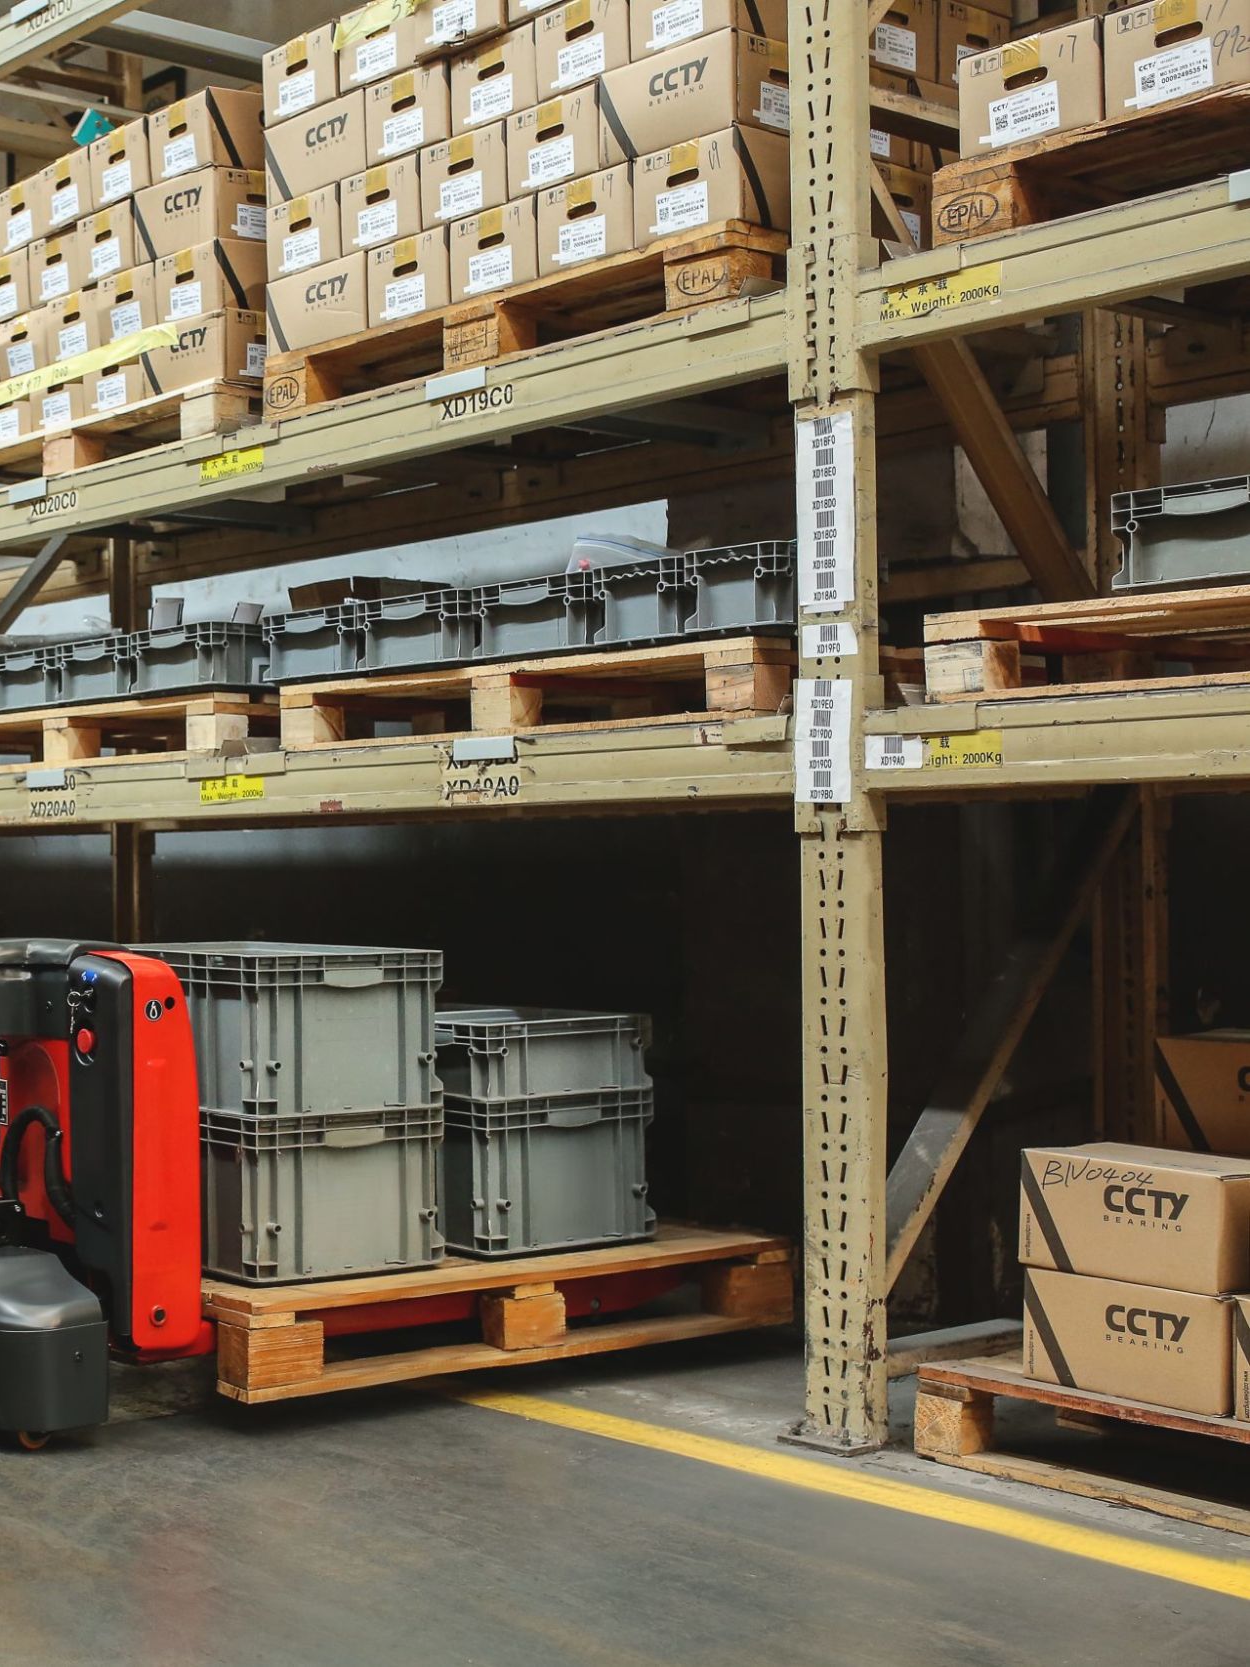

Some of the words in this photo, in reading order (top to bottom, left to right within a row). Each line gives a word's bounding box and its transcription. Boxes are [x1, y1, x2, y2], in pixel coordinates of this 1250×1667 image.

[649, 57, 708, 97] CCTY
[648, 84, 704, 107] BEARING
[305, 112, 348, 148] CCTY
[164, 186, 202, 214] CCTY
[947, 199, 990, 228] EPAL
[682, 267, 721, 290] EPAL
[305, 273, 349, 305] CCTY
[880, 308, 905, 321] Max.
[911, 294, 956, 313] Weight:
[960, 284, 999, 303] 2000Kg
[269, 383, 296, 404] EPAL
[441, 384, 514, 421] XD19C0
[811, 434, 836, 450] XD18F0
[812, 466, 837, 479] XD18E0
[30, 491, 77, 517] XD20C0
[812, 497, 837, 511] XD18D0
[813, 528, 837, 541] XD18C0
[812, 558, 837, 570] XD18B0
[813, 590, 838, 601] XD18A0
[816, 643, 841, 654] XD19F0
[810, 699, 834, 710] XD19E0
[809, 729, 833, 740] XD19D0
[808, 759, 833, 770] XD19C0
[880, 755, 906, 766] XD19A0
[962, 752, 1002, 765] 2000Kg
[809, 789, 834, 800] XD19B0
[30, 800, 76, 818] XD20A0
[1103, 1184, 1190, 1221] CCTY
[1103, 1214, 1183, 1233] BEARING
[1105, 1304, 1191, 1343] CCTY
[1105, 1334, 1184, 1354] BEARING
